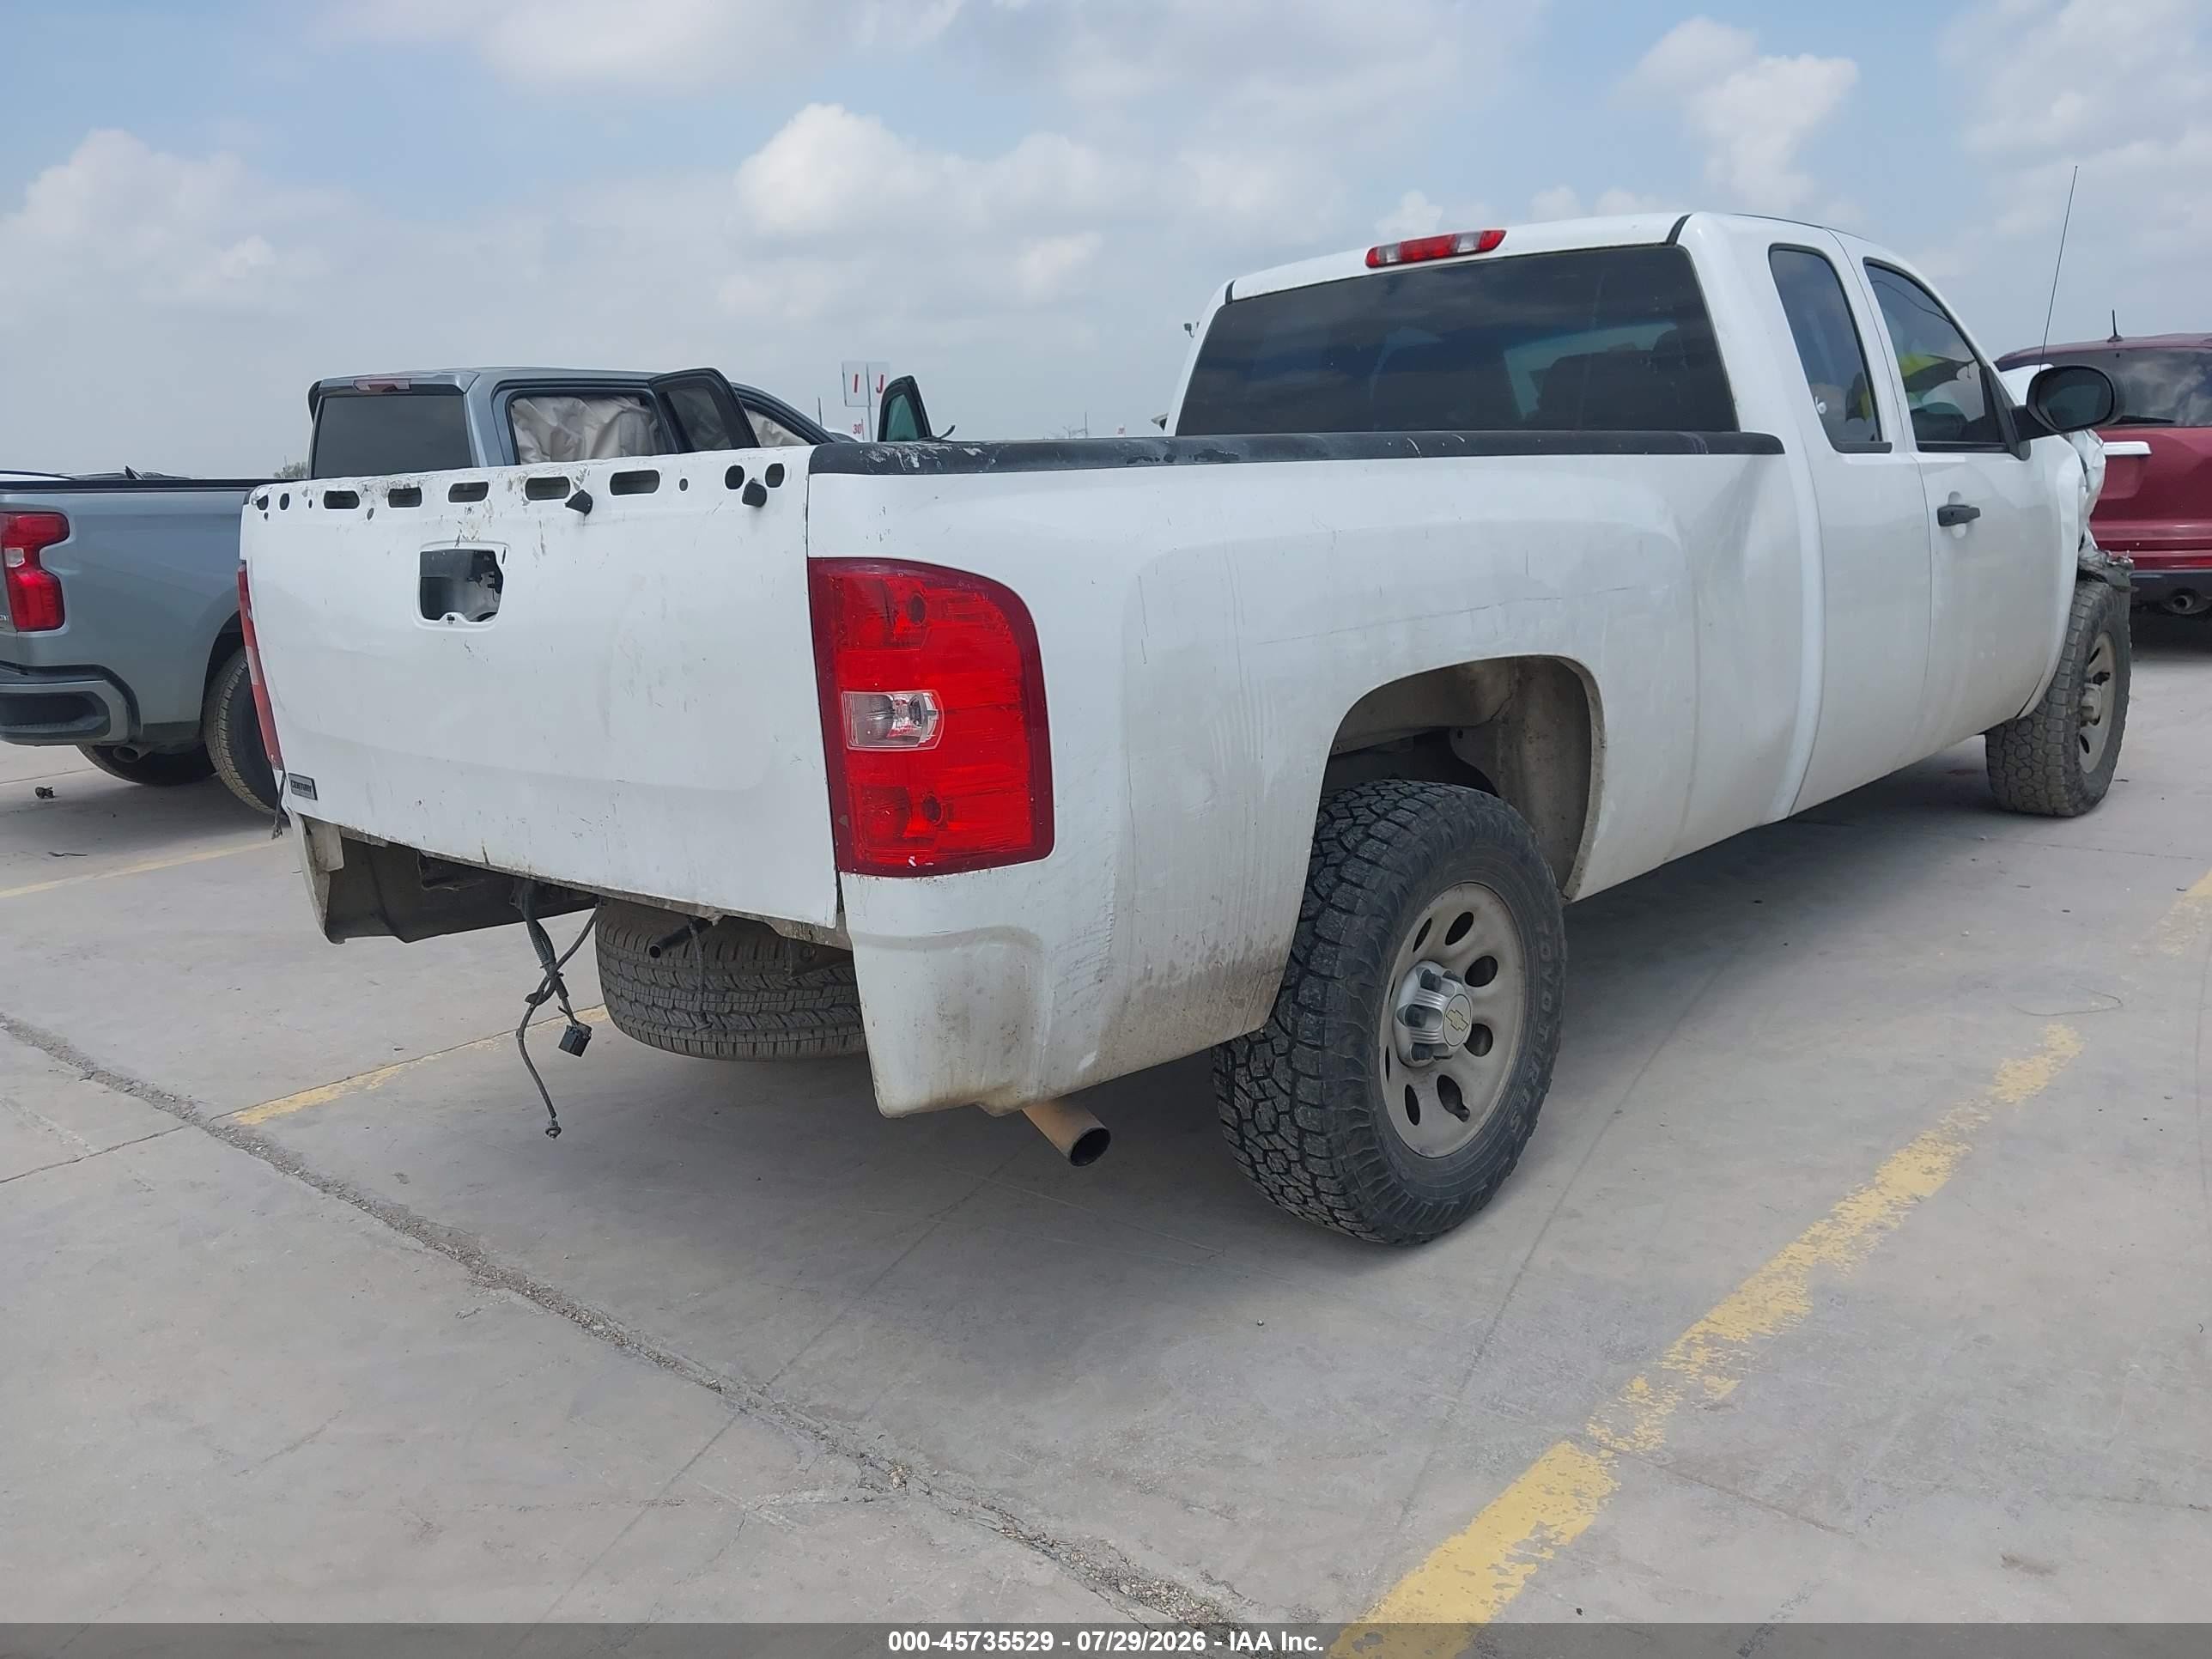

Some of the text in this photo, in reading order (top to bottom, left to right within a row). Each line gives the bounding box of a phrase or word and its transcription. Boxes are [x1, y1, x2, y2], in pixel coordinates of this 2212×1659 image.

[854, 374, 859, 393] I
[875, 374, 884, 393] J
[1536, 920, 1555, 1013] TOYO
